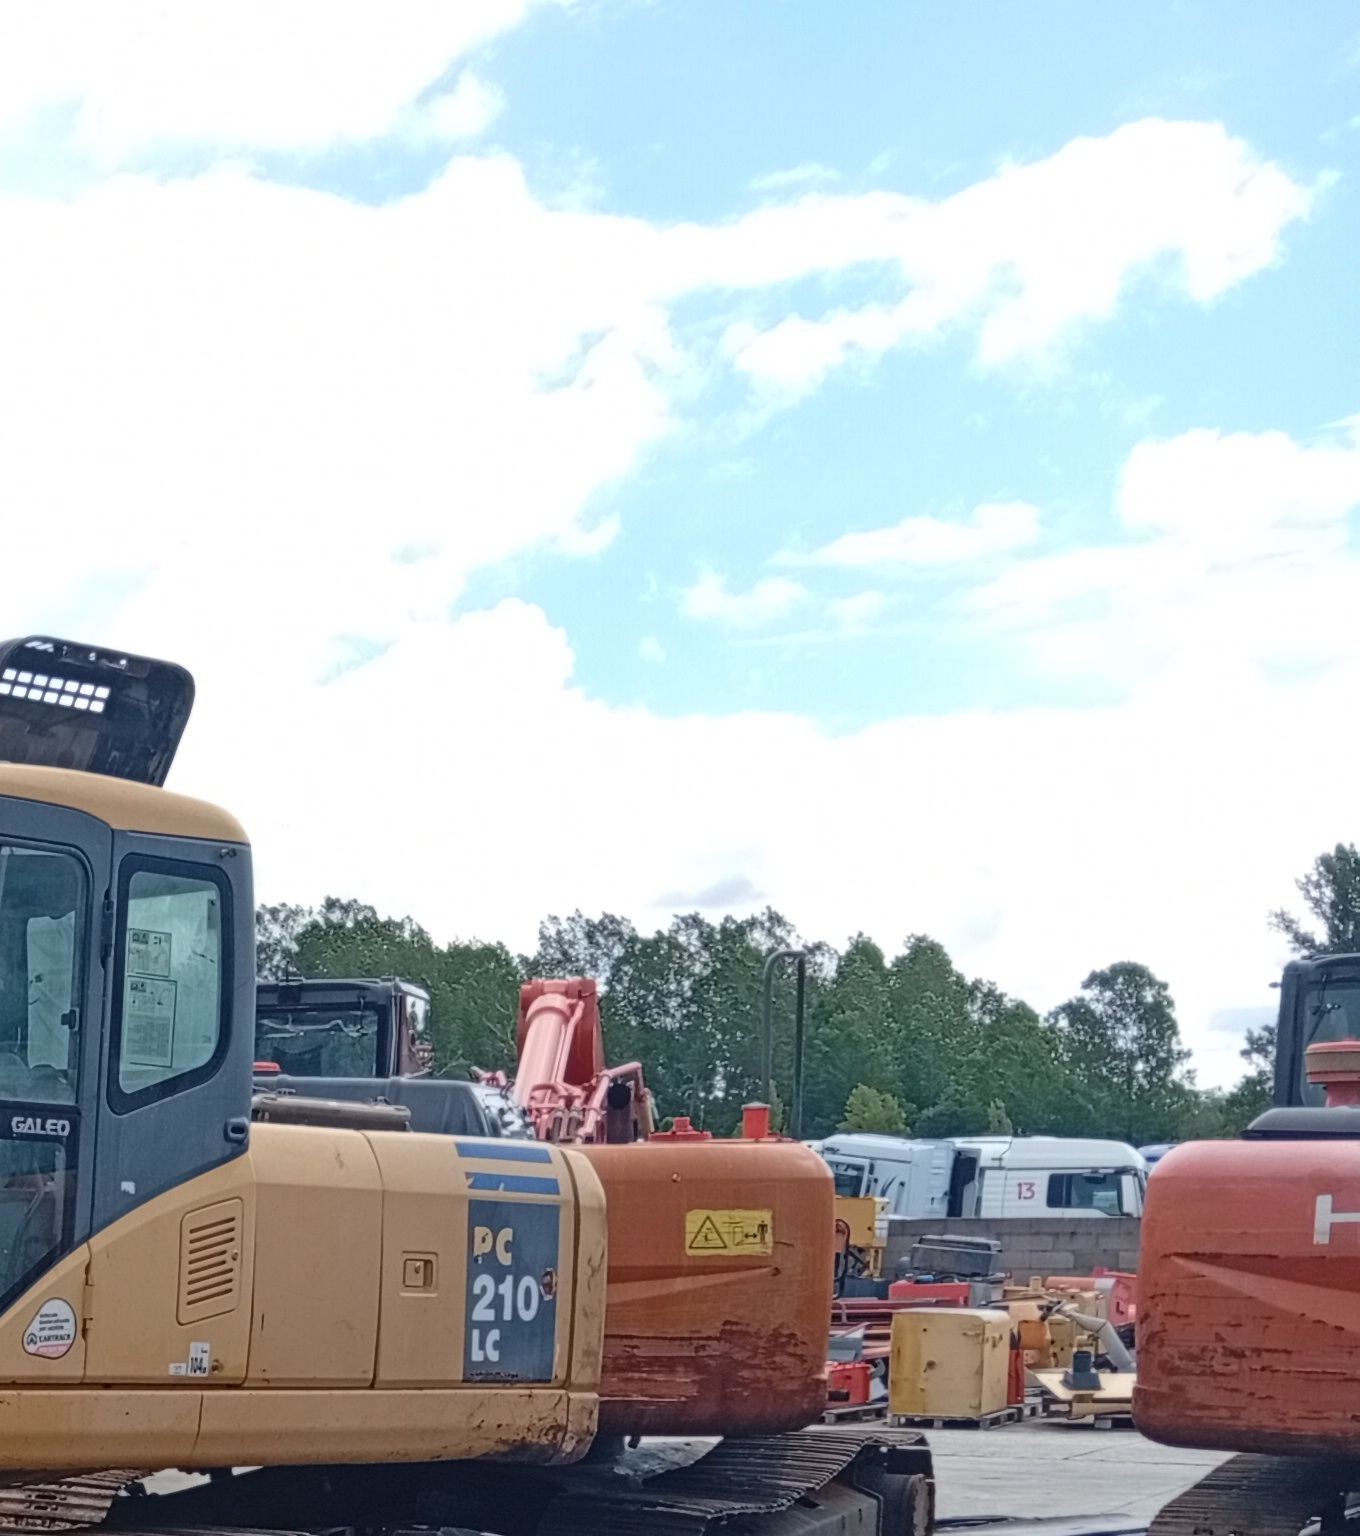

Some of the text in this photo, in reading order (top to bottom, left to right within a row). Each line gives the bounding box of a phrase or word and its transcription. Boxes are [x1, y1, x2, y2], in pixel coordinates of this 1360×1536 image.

[11, 1116, 70, 1137] GALEO
[1017, 1182, 1036, 1200] 13
[473, 1226, 514, 1266] PC
[471, 1273, 540, 1322] 210
[470, 1328, 501, 1362] LC
